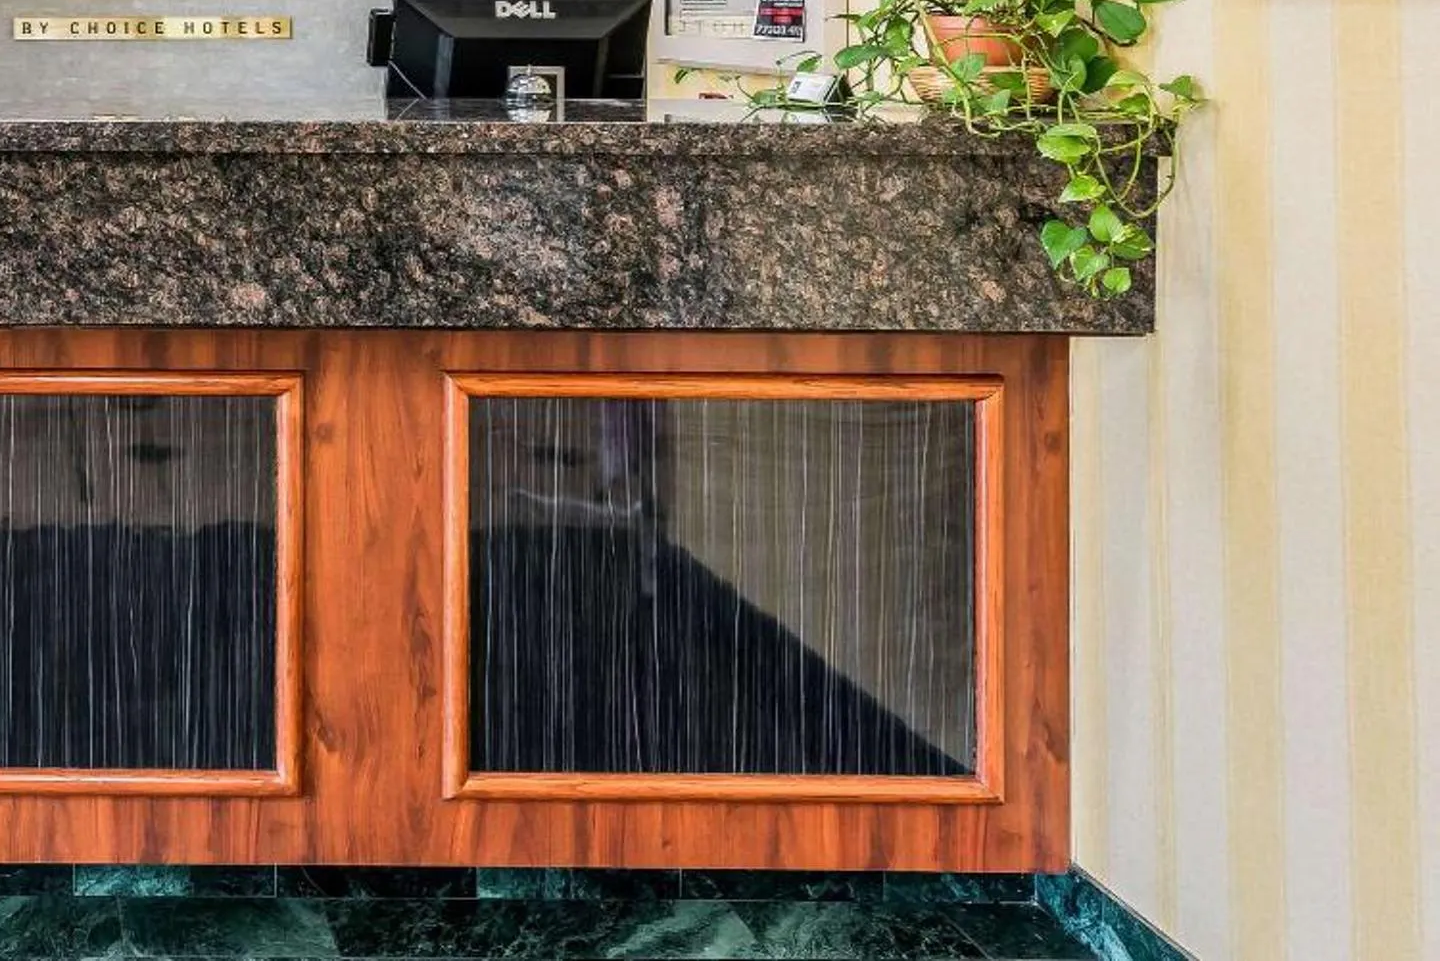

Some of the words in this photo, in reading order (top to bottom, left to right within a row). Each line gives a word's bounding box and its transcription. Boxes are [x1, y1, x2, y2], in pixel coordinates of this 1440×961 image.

[495, 0, 557, 19] DELL
[21, 21, 49, 35] BY
[69, 21, 165, 35] CHOICE
[183, 21, 282, 35] HOTELS
